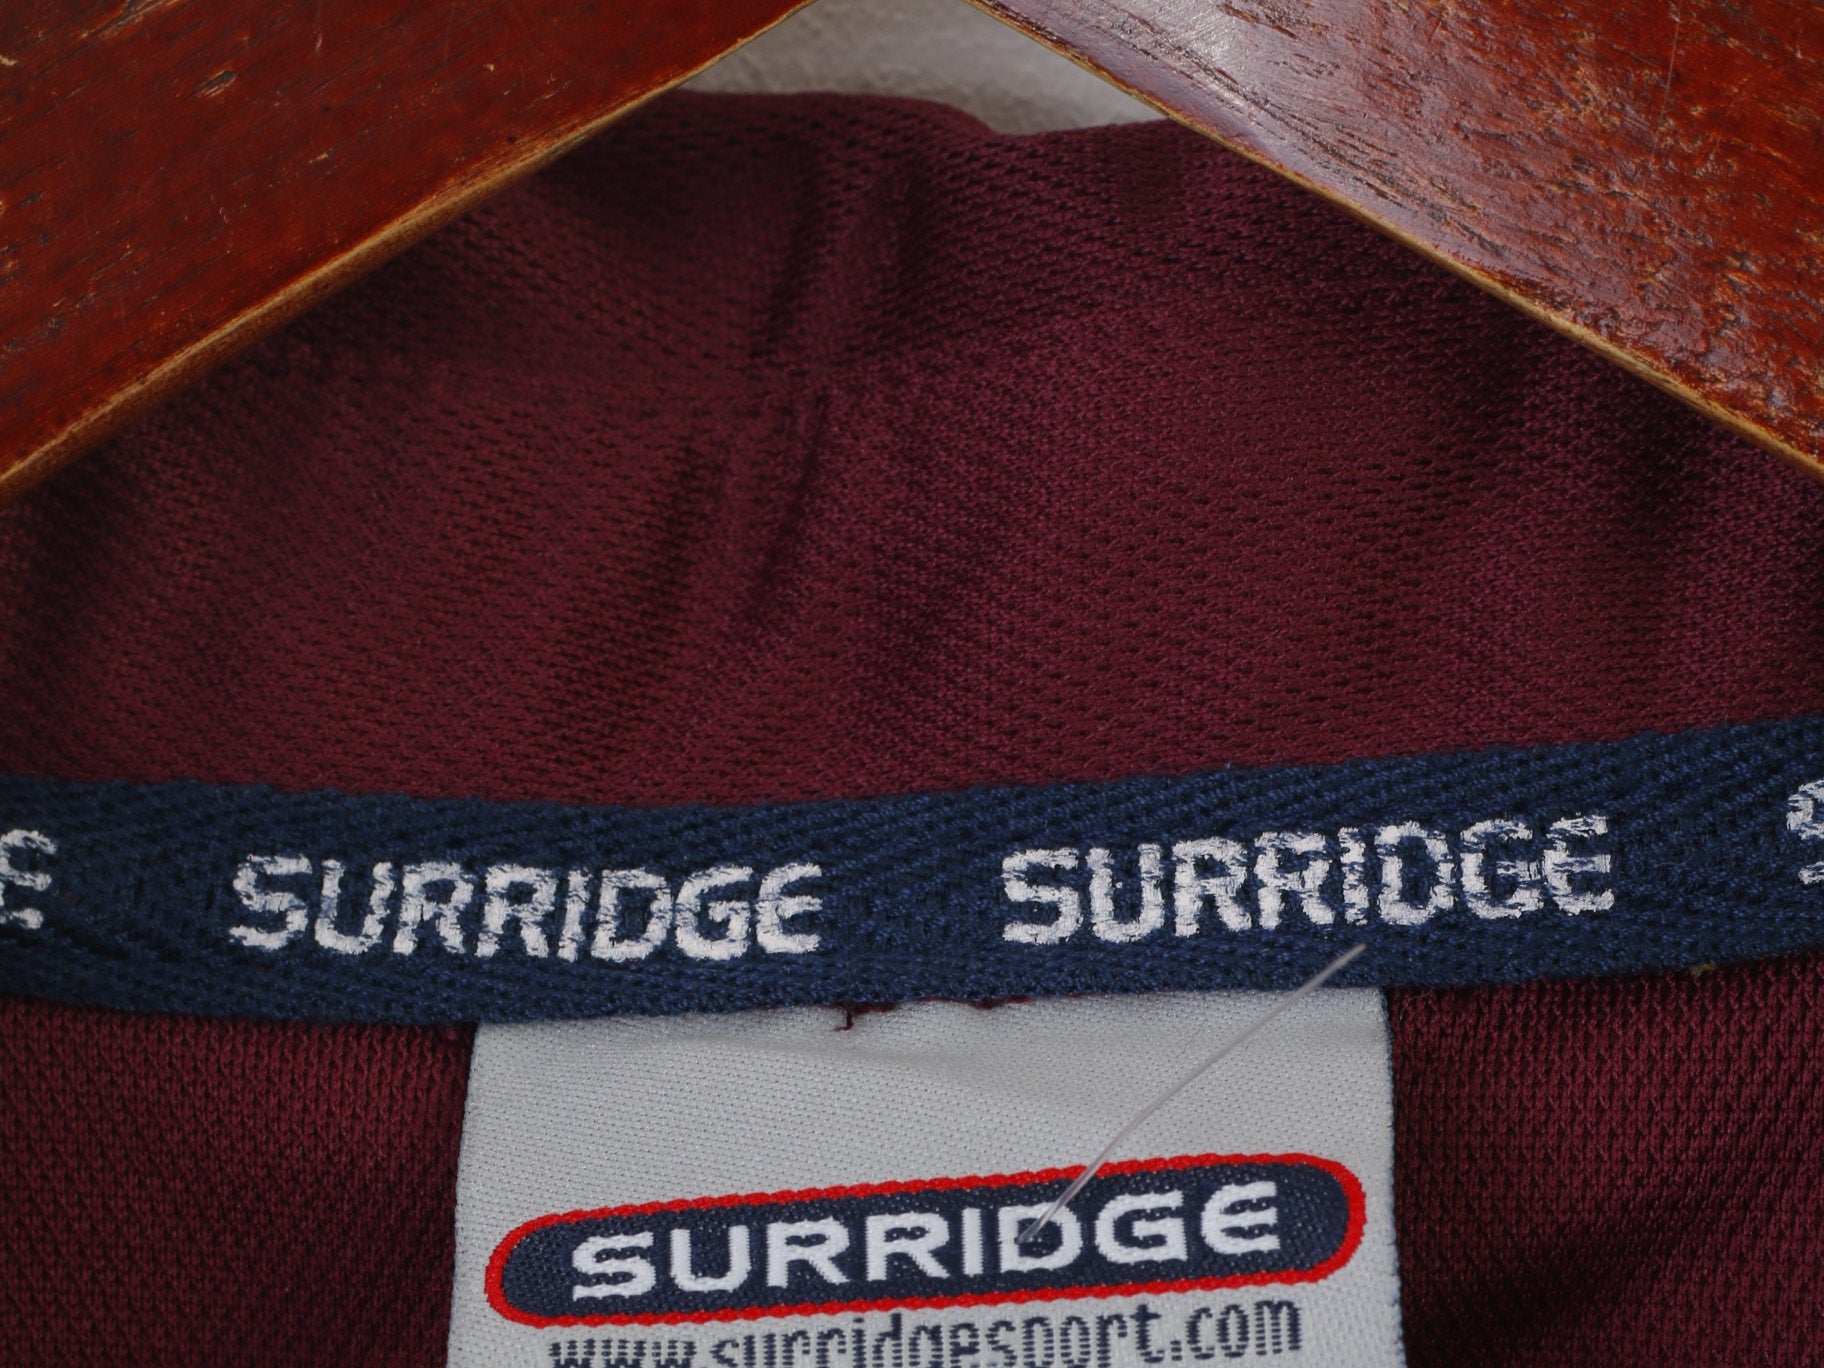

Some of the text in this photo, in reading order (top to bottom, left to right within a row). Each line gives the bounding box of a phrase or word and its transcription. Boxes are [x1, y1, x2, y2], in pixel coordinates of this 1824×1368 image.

[230, 854, 823, 961] SURRIDGE
[1002, 813, 1613, 945] SURRIDGE
[572, 1181, 1281, 1302] SURRIDGE
